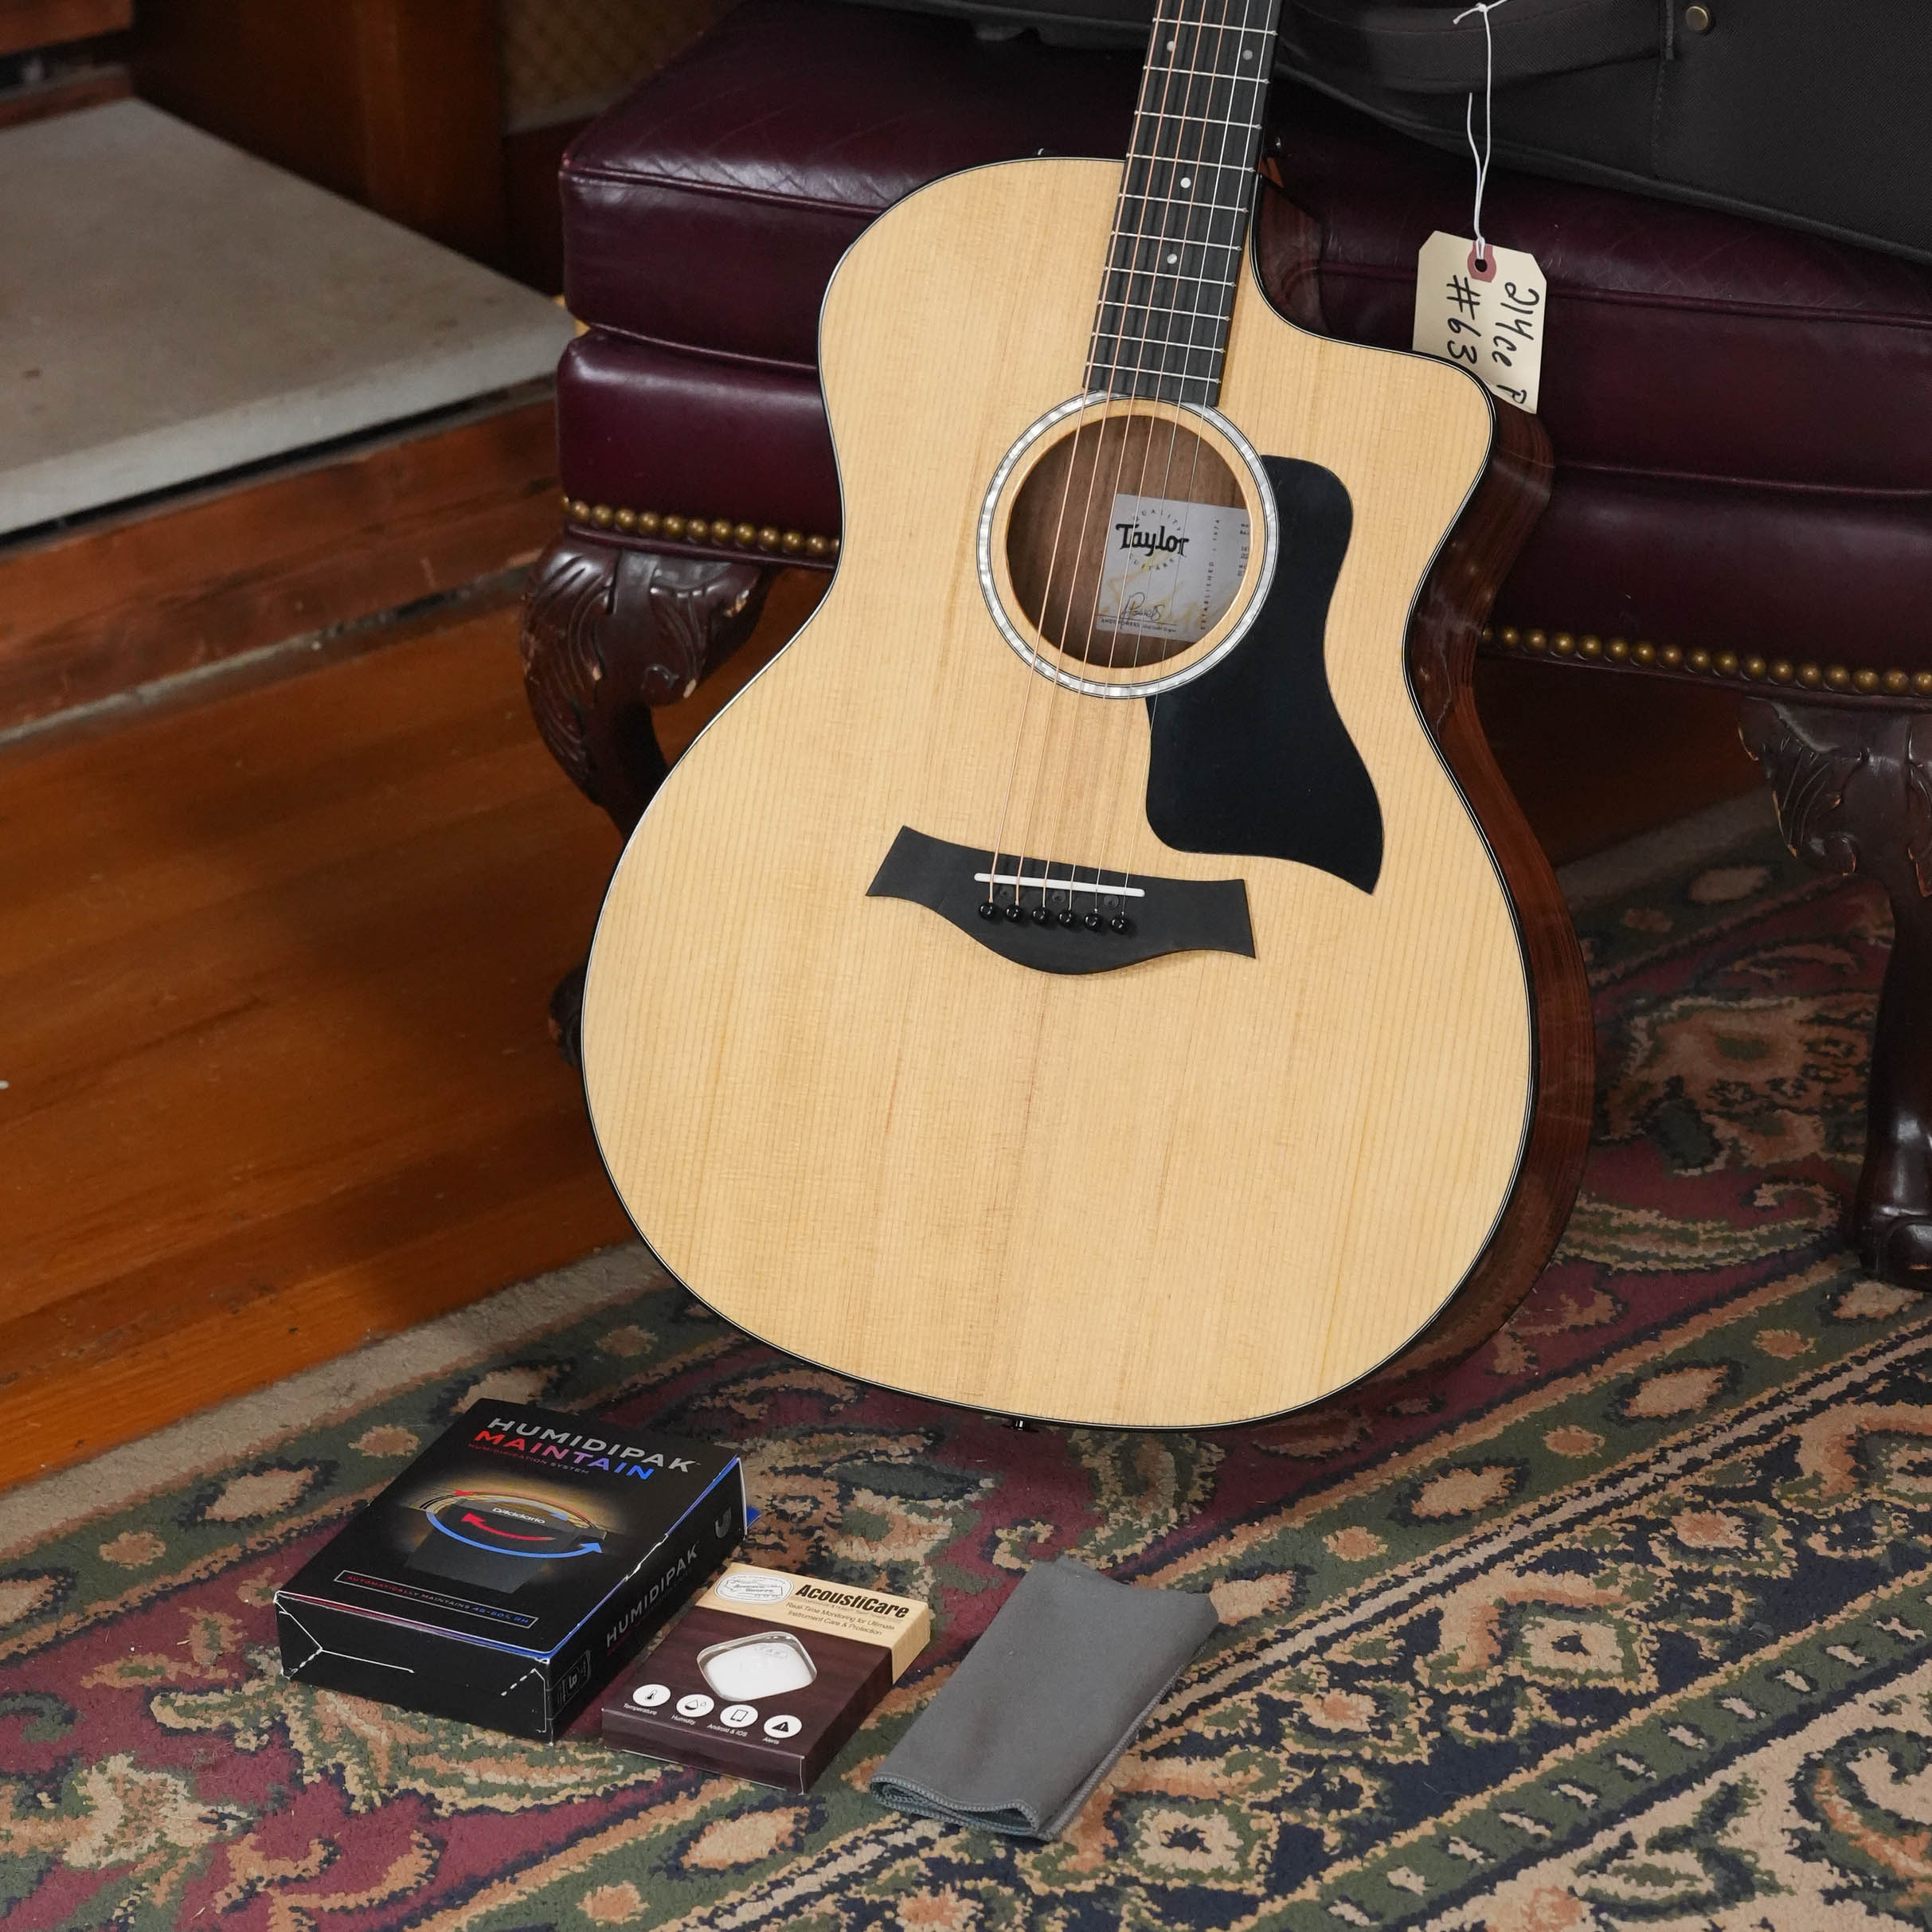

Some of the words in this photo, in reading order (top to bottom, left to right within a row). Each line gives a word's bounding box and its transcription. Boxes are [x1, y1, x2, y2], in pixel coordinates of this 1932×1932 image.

[1446, 275, 1482, 365] #63
[1115, 523, 1190, 557] Taylor
[474, 1430, 655, 1480] MAINTAIN
[487, 1418, 698, 1472] HUMIDIPAK
[346, 1574, 419, 1597] AUTOMATICALLY
[420, 1593, 471, 1610] MAINTAINS
[606, 1543, 699, 1648] HUMIDIPAK
[795, 1584, 909, 1618] AcoustiCare
[823, 1617, 841, 1626] Care
[848, 1623, 883, 1636] Protection
[623, 1702, 658, 1716] Temperature
[671, 1714, 697, 1726] Humidity
[762, 1736, 780, 1746] Alerts
